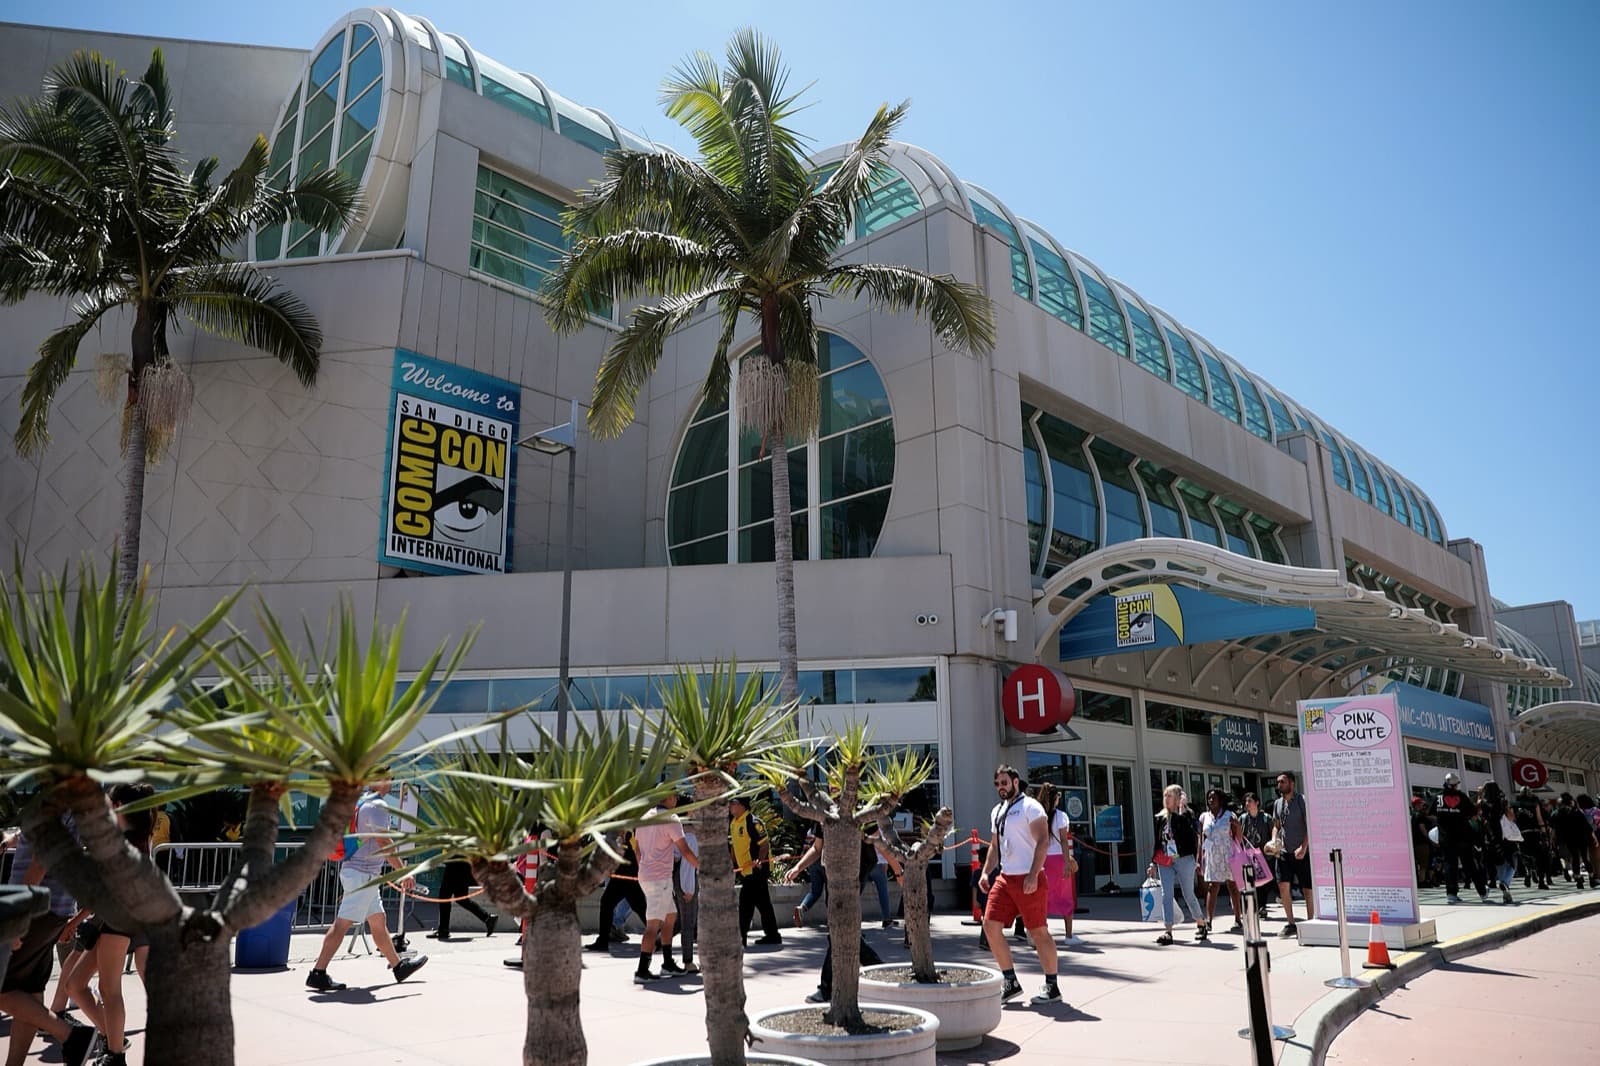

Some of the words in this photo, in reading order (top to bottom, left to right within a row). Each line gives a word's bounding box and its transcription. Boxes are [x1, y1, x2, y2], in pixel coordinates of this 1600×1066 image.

[401, 362, 490, 405] Welcome
[496, 394, 515, 412] to
[401, 400, 437, 421] SAN
[454, 414, 508, 440] DIEGO
[440, 429, 506, 479] CON
[395, 418, 437, 537] COMIC
[391, 535, 502, 572] INTERNATIONAL
[1118, 602, 1130, 640] COMIC
[1129, 599, 1151, 614] CON
[1017, 677, 1045, 720] H
[1225, 719, 1243, 736] HALL
[1336, 726, 1386, 741] ROUTE
[1343, 711, 1376, 726] PINK
[1437, 713, 1494, 740] INTERNATIONAL
[1220, 737, 1258, 755] PROGRAMS
[1520, 763, 1540, 783] G
